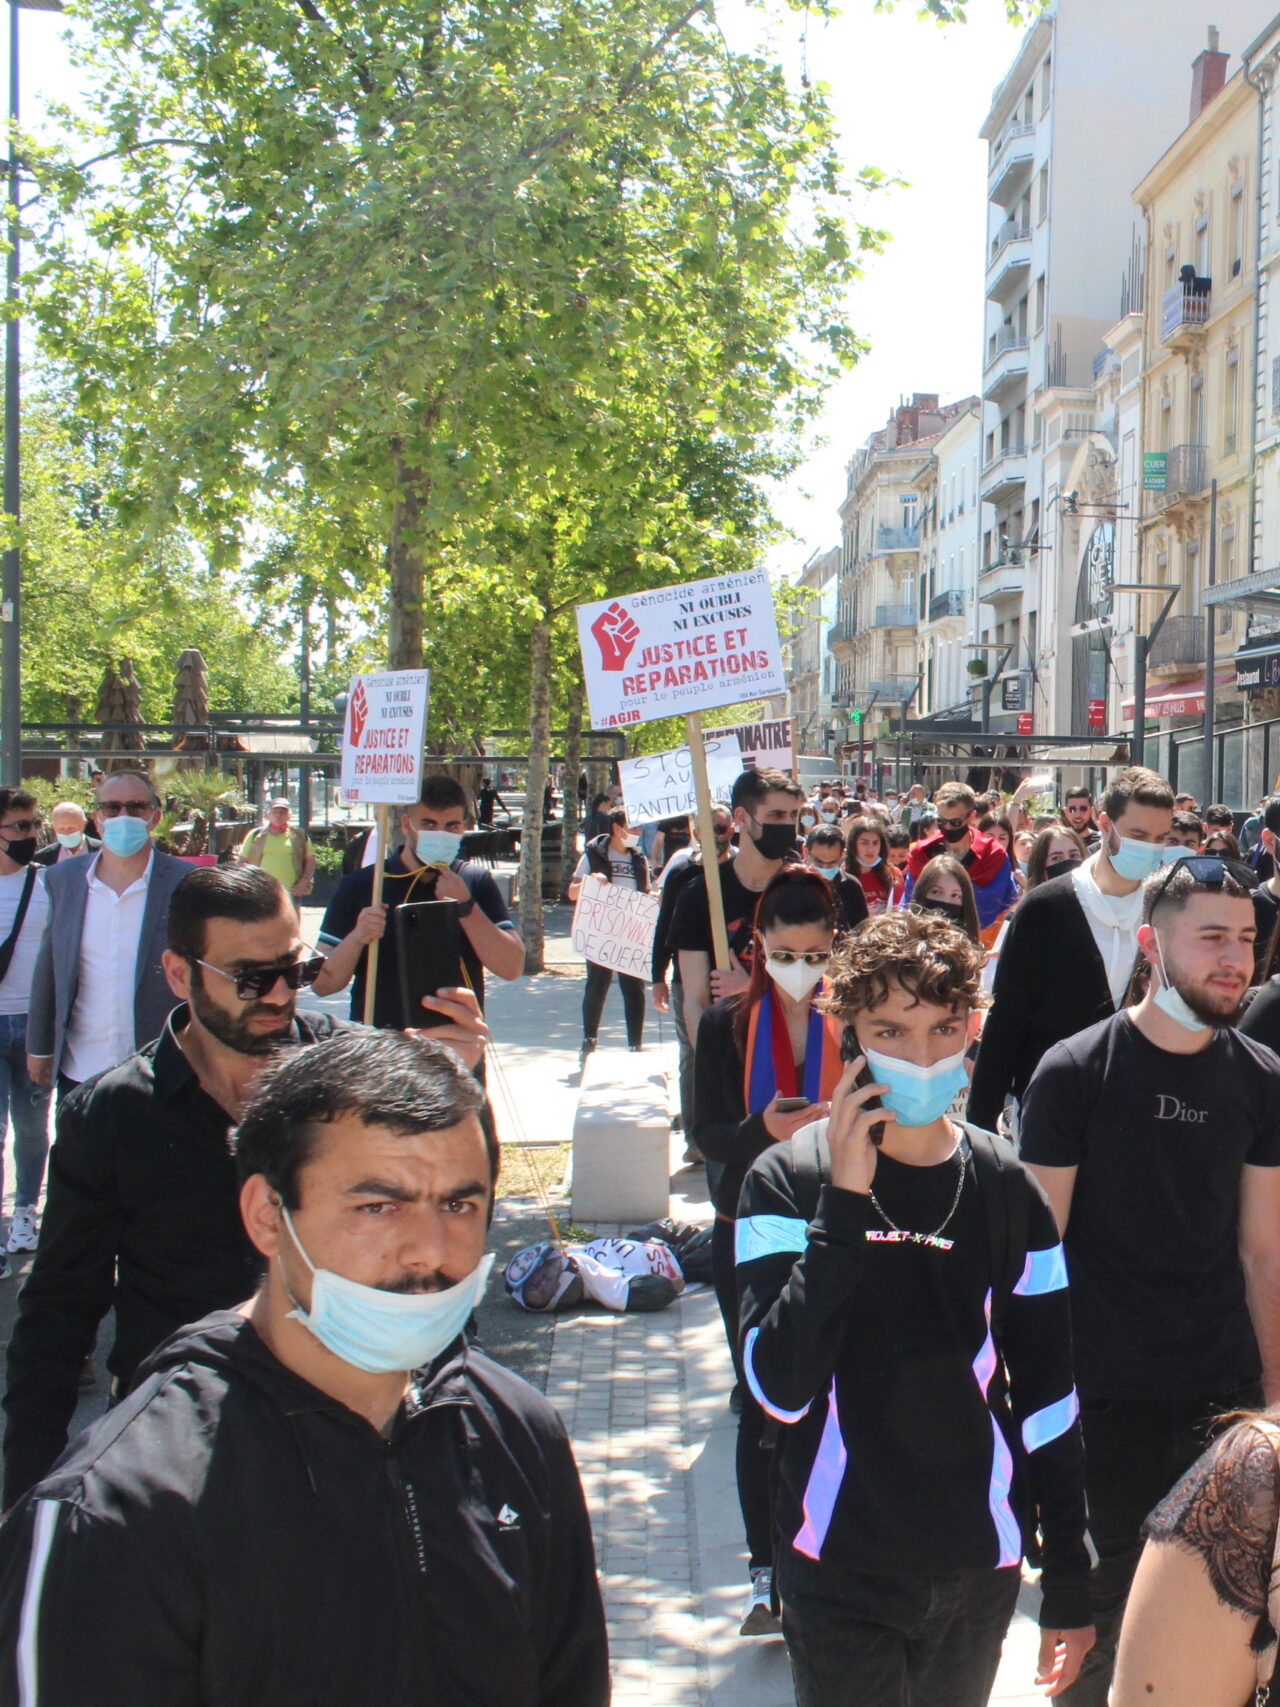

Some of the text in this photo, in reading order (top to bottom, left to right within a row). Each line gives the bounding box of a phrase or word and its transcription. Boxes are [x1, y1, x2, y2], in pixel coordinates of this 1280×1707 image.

[632, 573, 765, 608] Génocide arménien
[679, 591, 741, 615] NI OUBLI
[673, 605, 752, 632] NI EXCUSES
[637, 628, 748, 669] JUSTICE ET
[622, 651, 769, 696] REPARATIONS
[600, 709, 641, 727] #AGJR
[620, 697, 648, 711] pour
[363, 728, 410, 749] JUSTICE ET
[355, 753, 415, 774] REPARATIONS
[664, 771, 690, 788] AU
[581, 875, 659, 919] LIBEREZ
[578, 898, 655, 949] PRISONNI
[575, 929, 653, 974] DE GUERR
[1154, 1094, 1208, 1123] Dior
